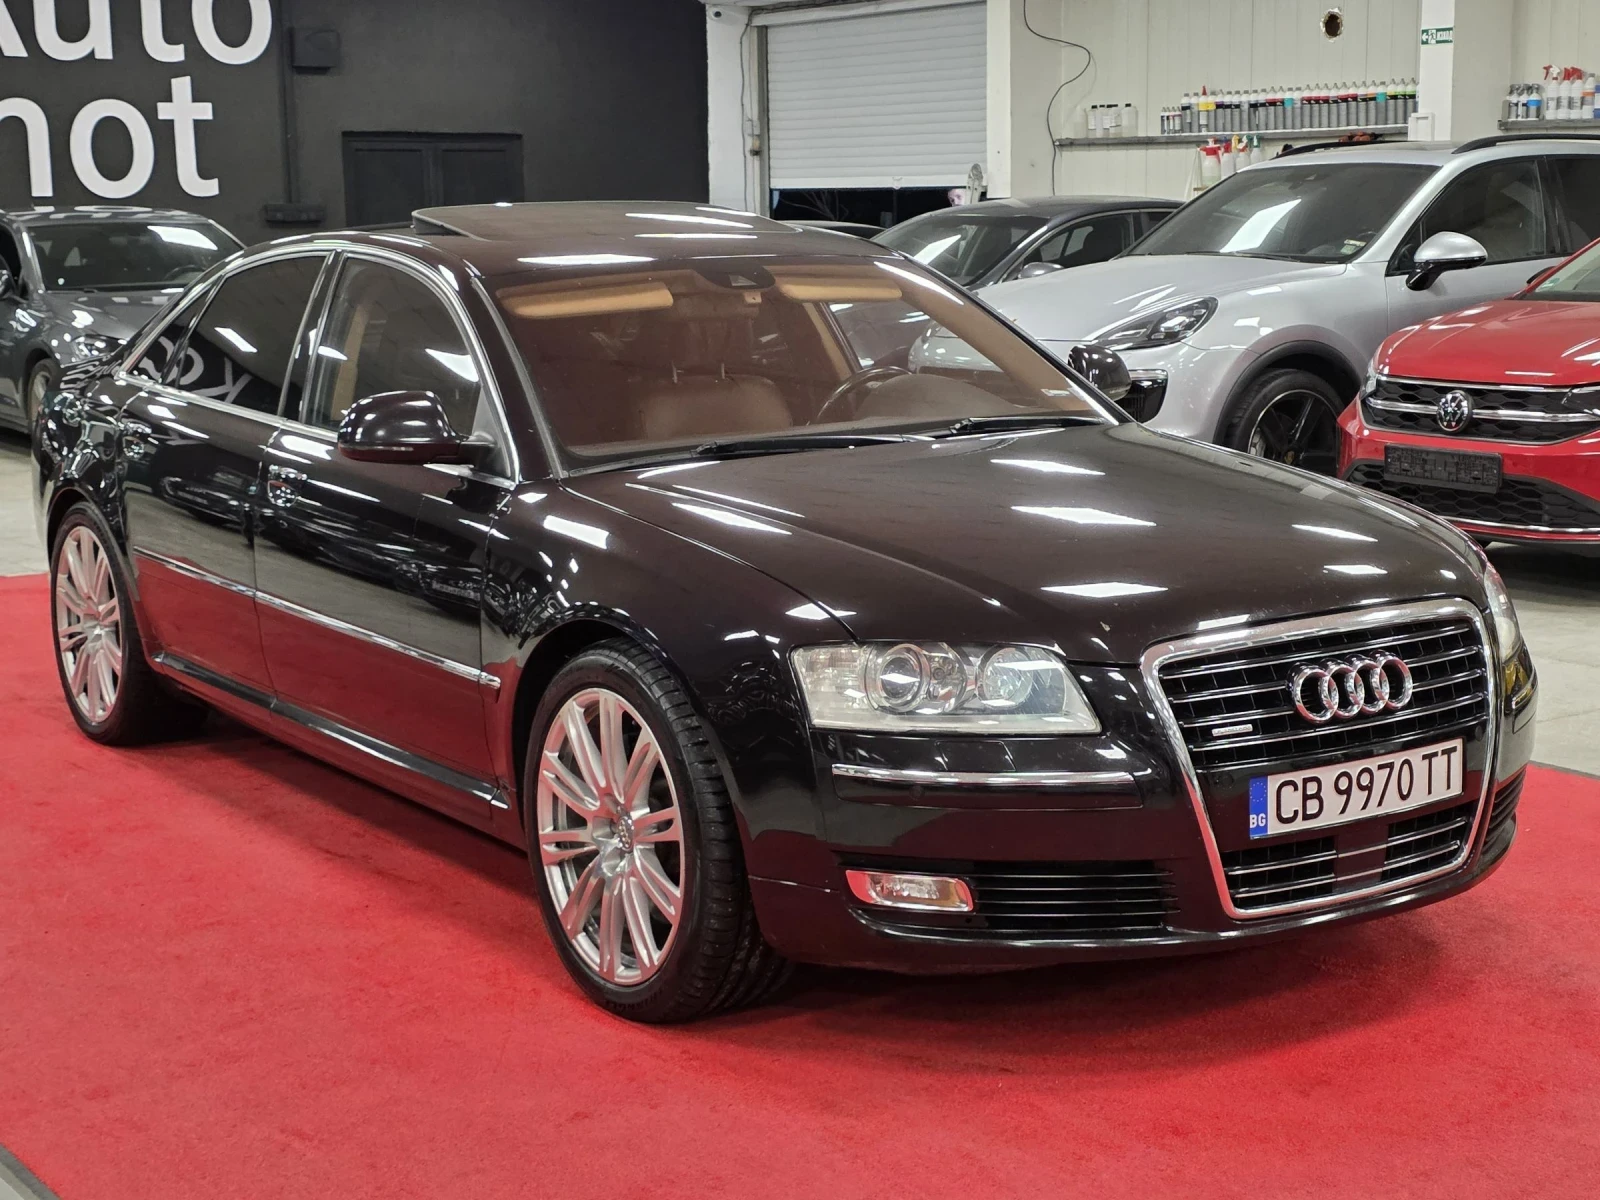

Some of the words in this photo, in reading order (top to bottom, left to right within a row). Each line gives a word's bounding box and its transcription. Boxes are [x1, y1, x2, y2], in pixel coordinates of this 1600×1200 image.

[1275, 776, 1324, 825] CB
[1333, 758, 1415, 816] 9970
[1421, 745, 1458, 797] TT
[1249, 813, 1267, 829] BG
